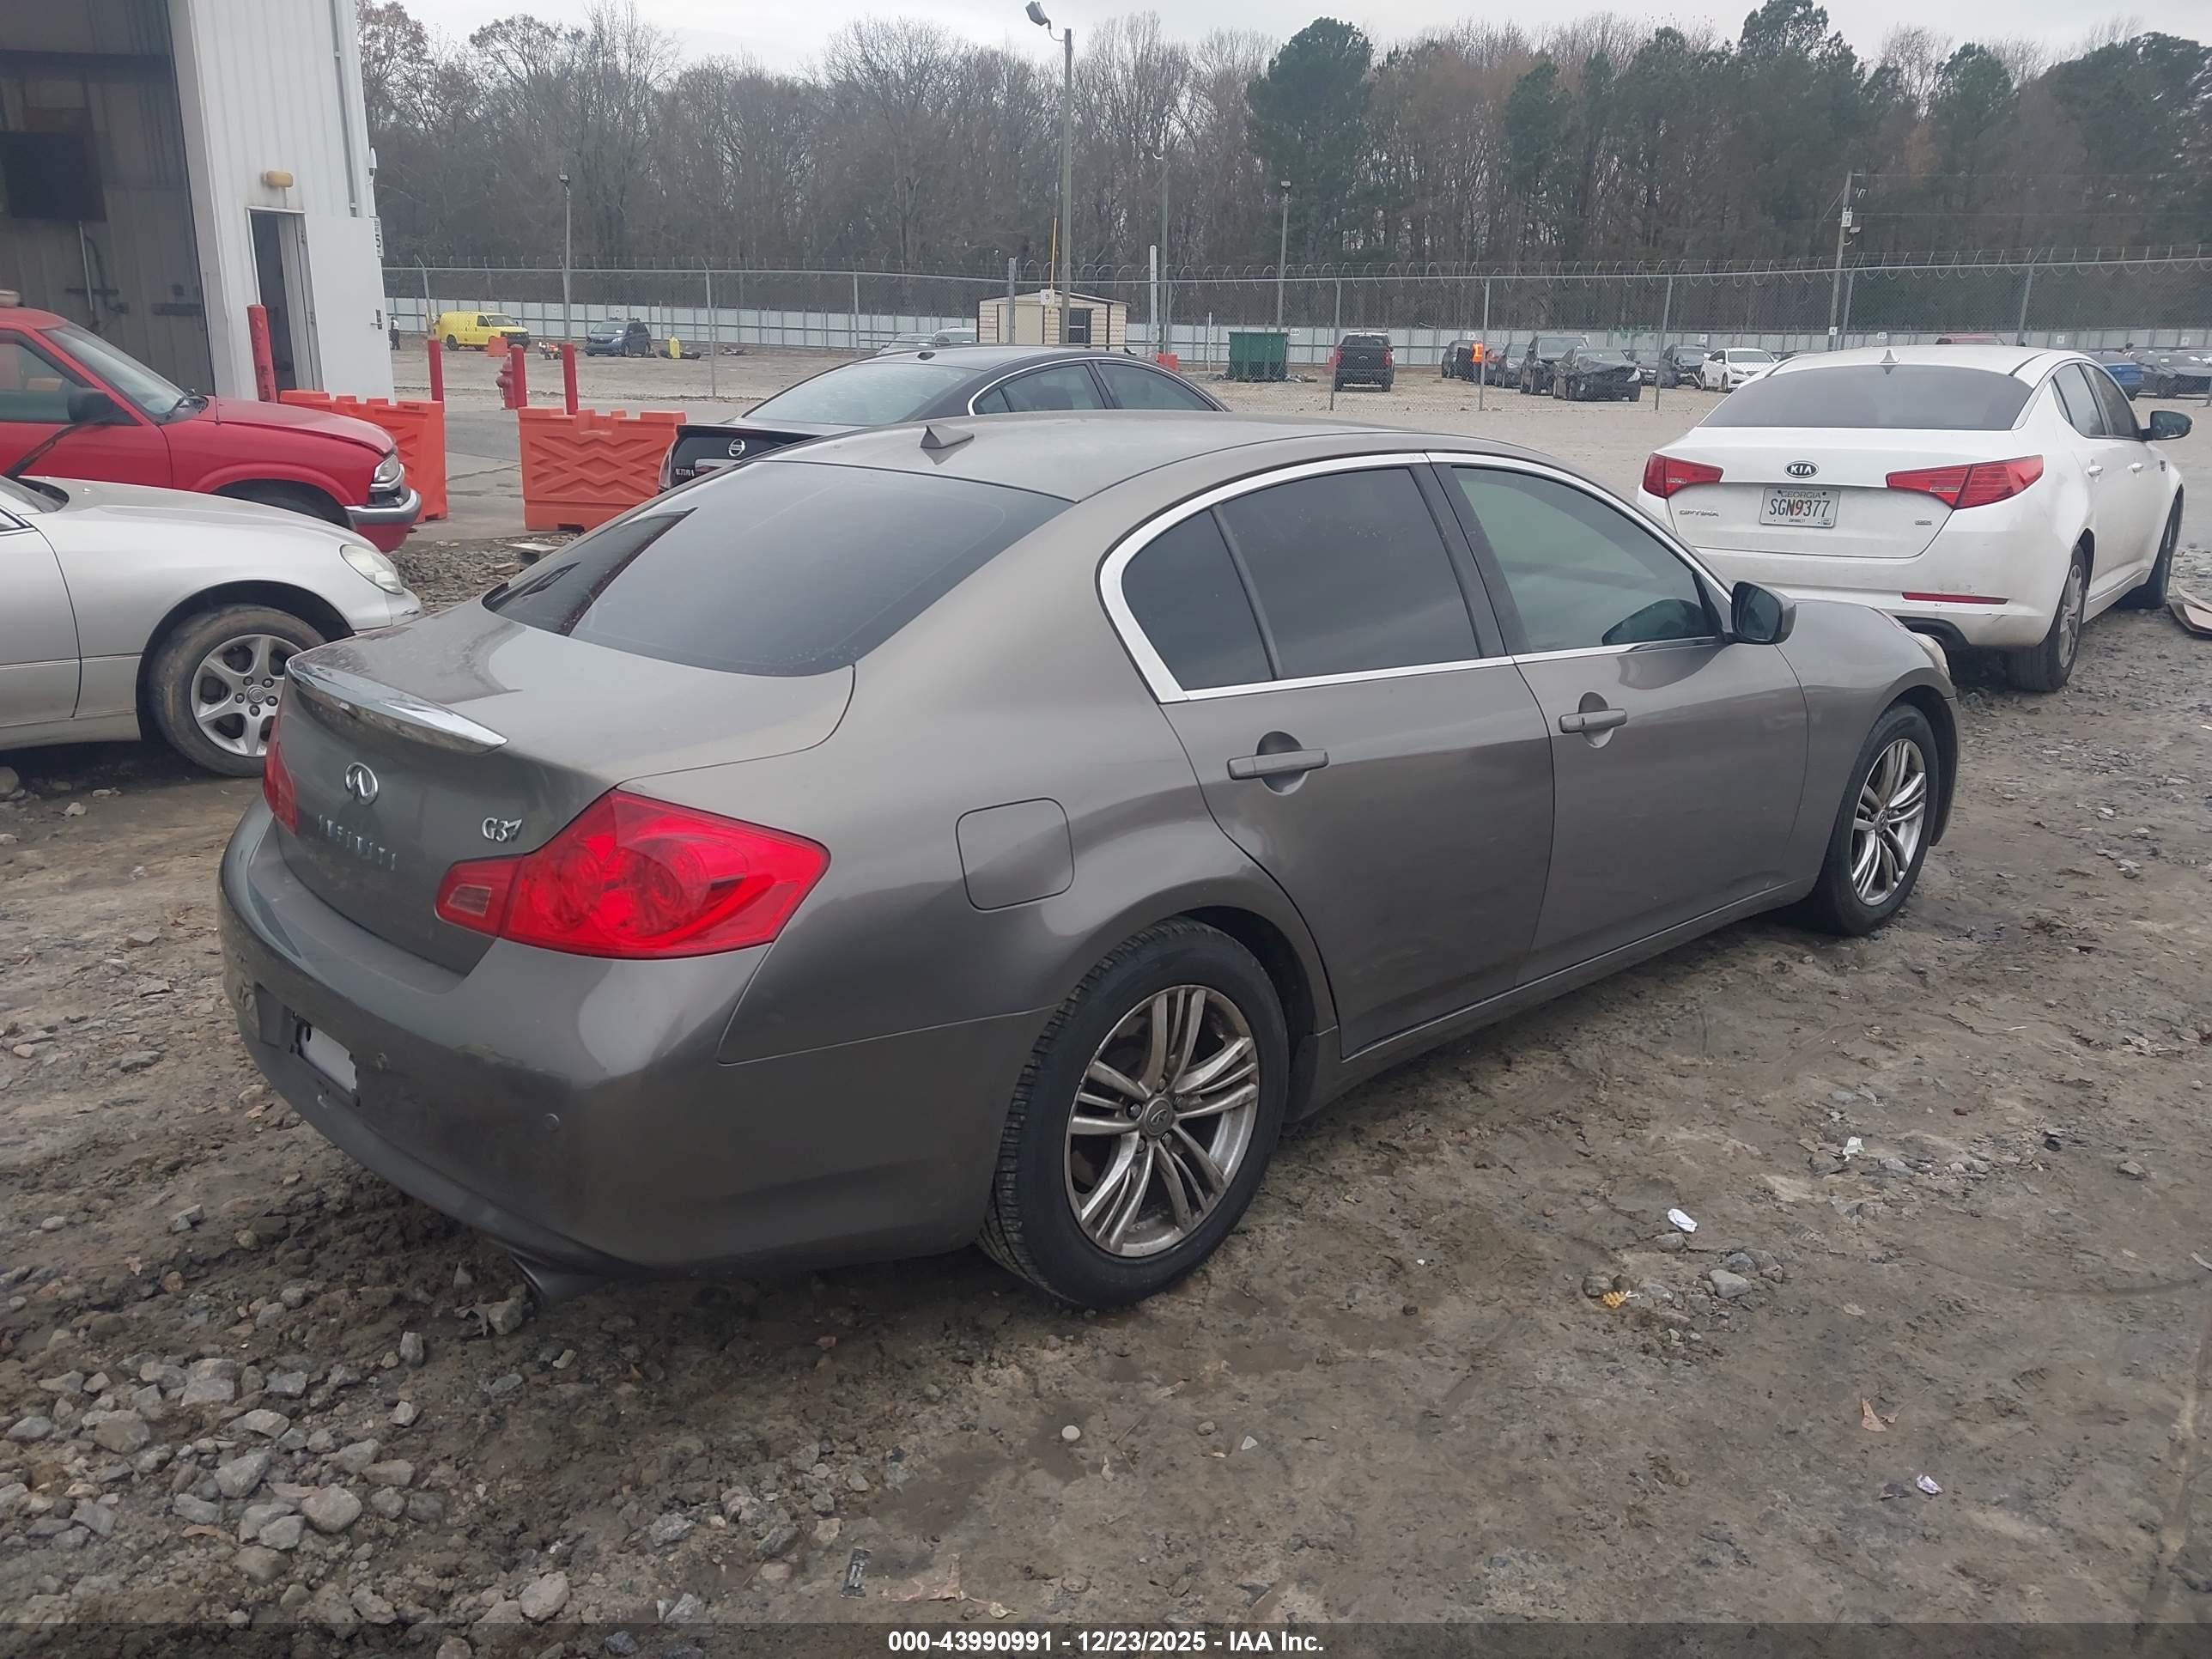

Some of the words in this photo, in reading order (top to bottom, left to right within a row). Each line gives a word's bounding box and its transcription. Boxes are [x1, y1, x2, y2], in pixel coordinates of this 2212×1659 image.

[1790, 465, 1813, 475] KIA
[1780, 490, 1821, 499] GEORGIA
[1769, 498, 1831, 518] SGN9377
[481, 816, 523, 843] G37
